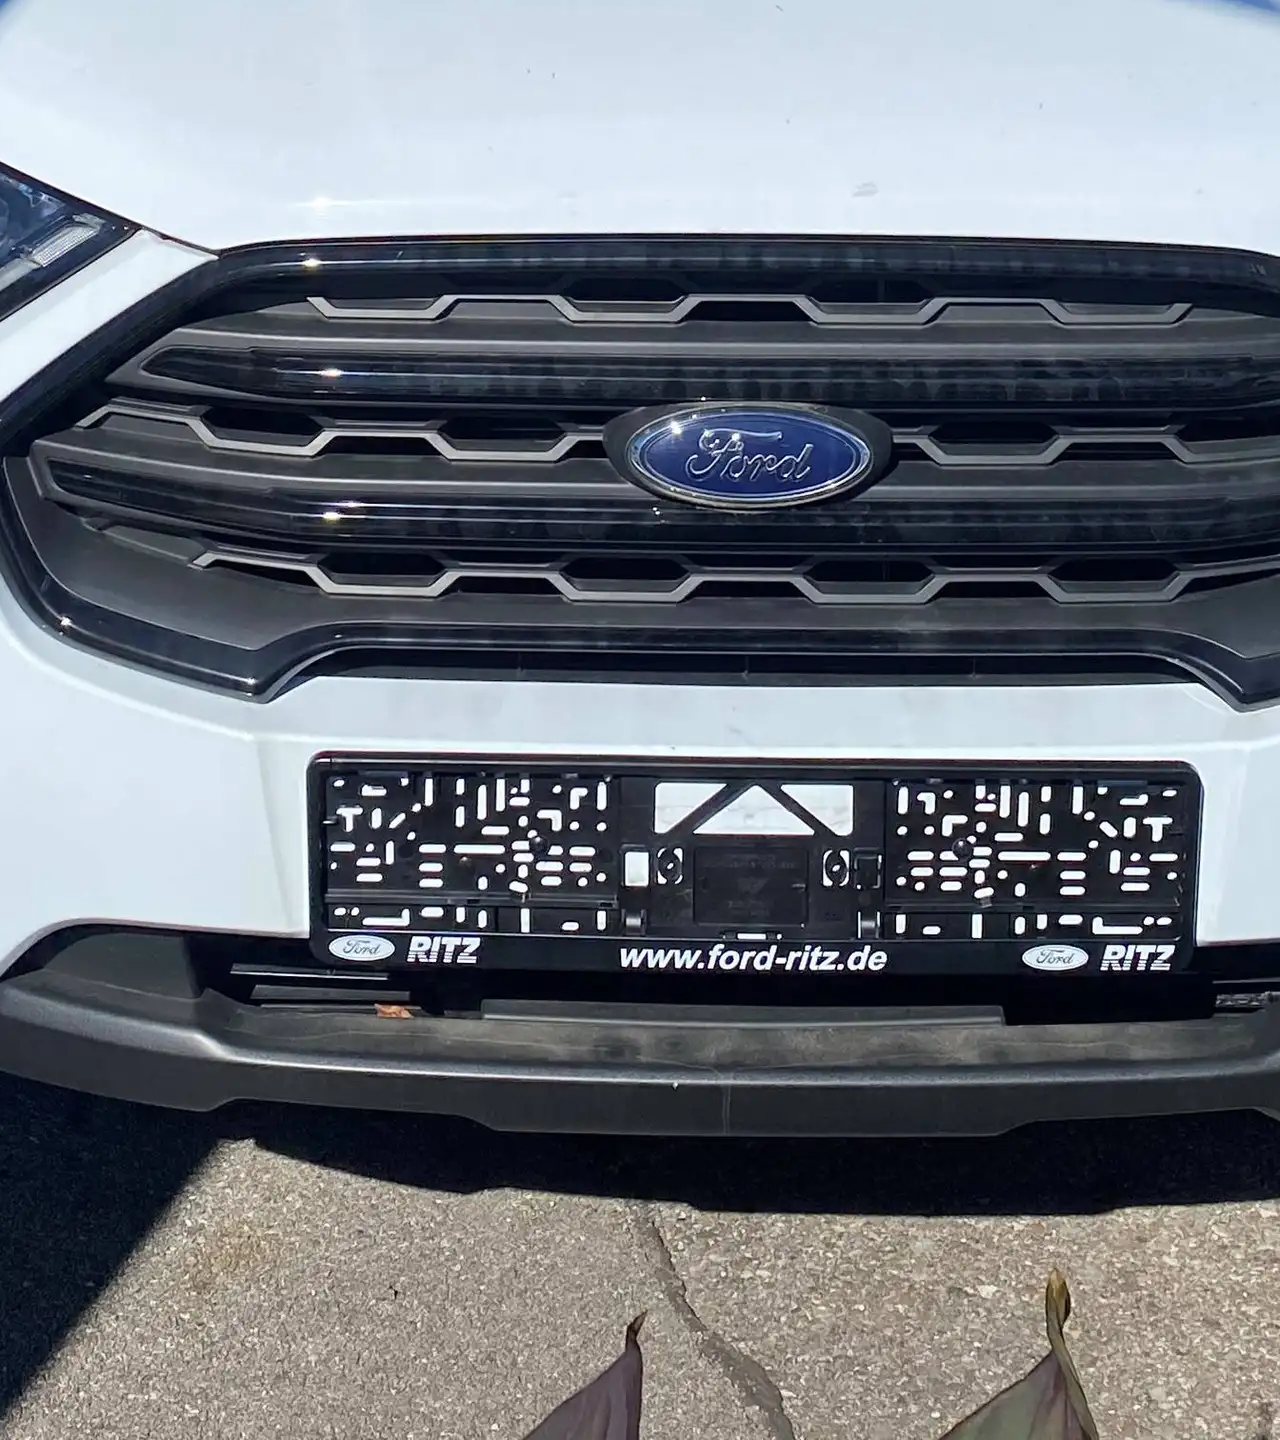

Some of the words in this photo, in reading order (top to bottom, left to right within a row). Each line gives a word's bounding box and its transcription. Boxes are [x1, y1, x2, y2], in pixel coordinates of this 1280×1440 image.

[685, 427, 814, 482] Ford
[342, 939, 381, 955] Ford
[406, 935, 481, 964] RITZ
[619, 943, 888, 971] www.ford-ritz.de
[1036, 948, 1074, 965] Ford
[1099, 944, 1176, 971] RITZ
